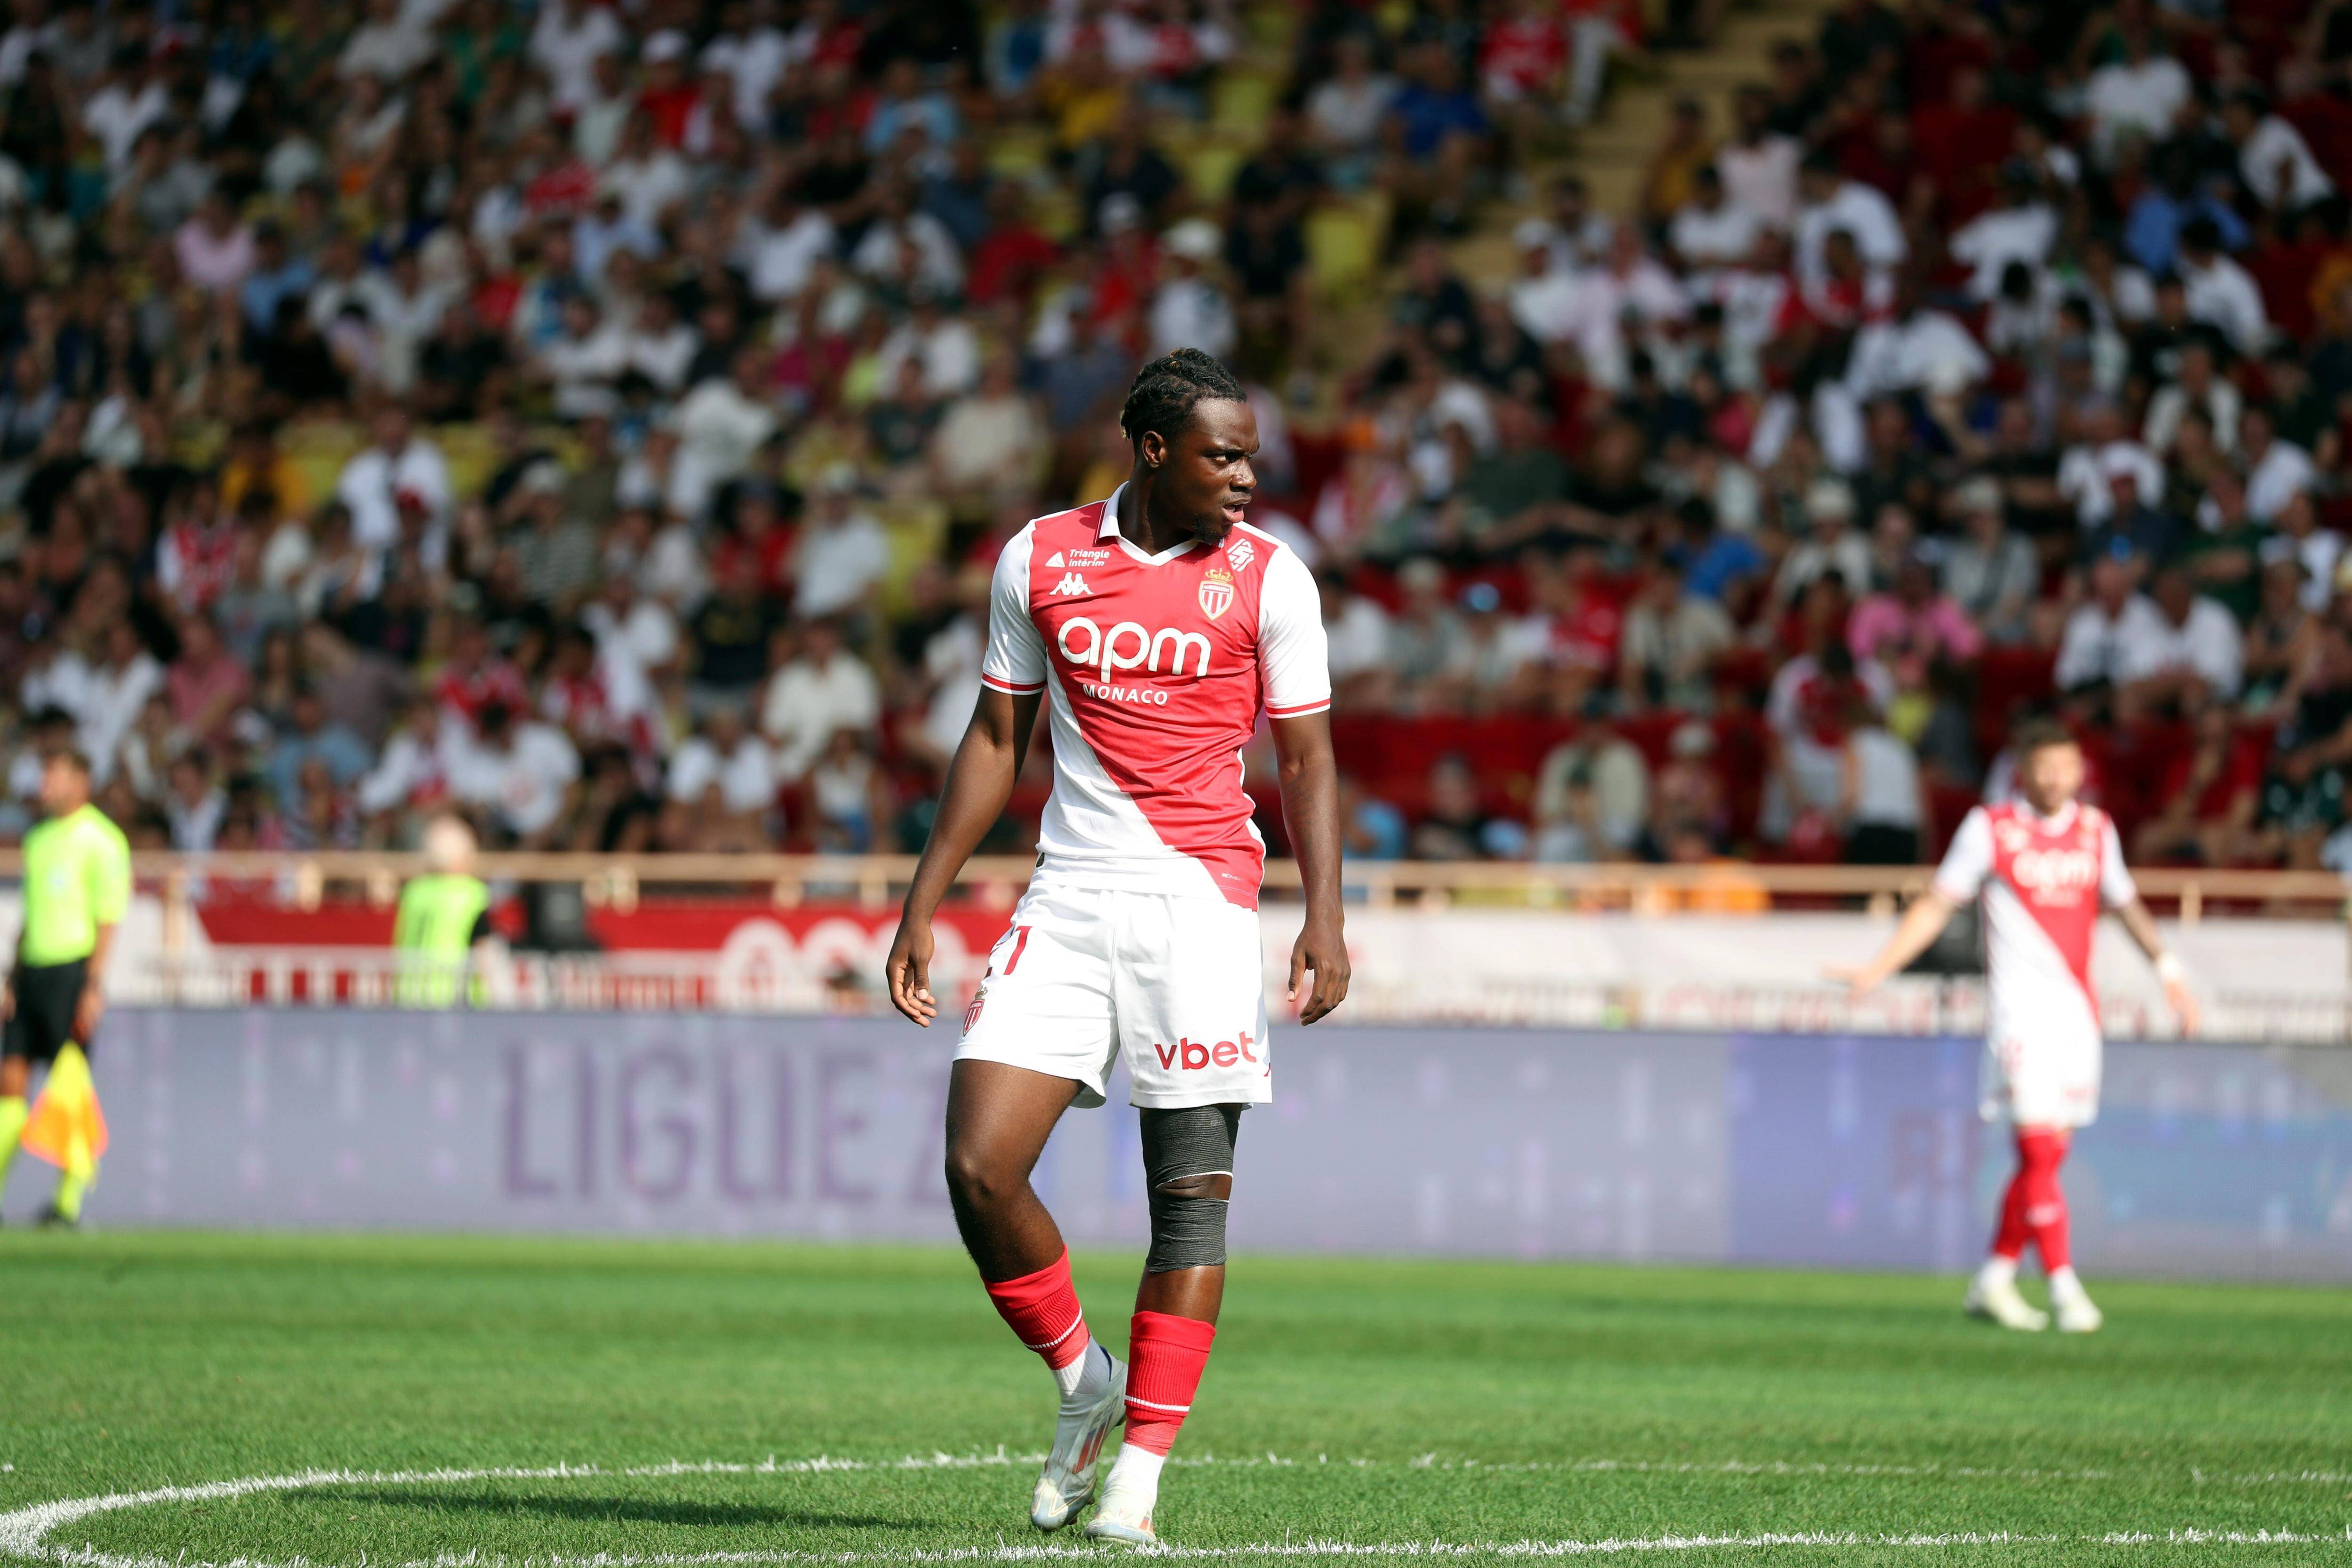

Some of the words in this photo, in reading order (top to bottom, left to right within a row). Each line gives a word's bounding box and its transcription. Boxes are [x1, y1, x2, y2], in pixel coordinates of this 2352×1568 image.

[1068, 558, 1105, 567] intérim
[1069, 549, 1111, 560] Triangle
[1057, 616, 1212, 684] apm
[1082, 684, 1168, 706] MONACO
[1154, 1031, 1257, 1070] vbet
[501, 1045, 874, 1203] LIGUE
